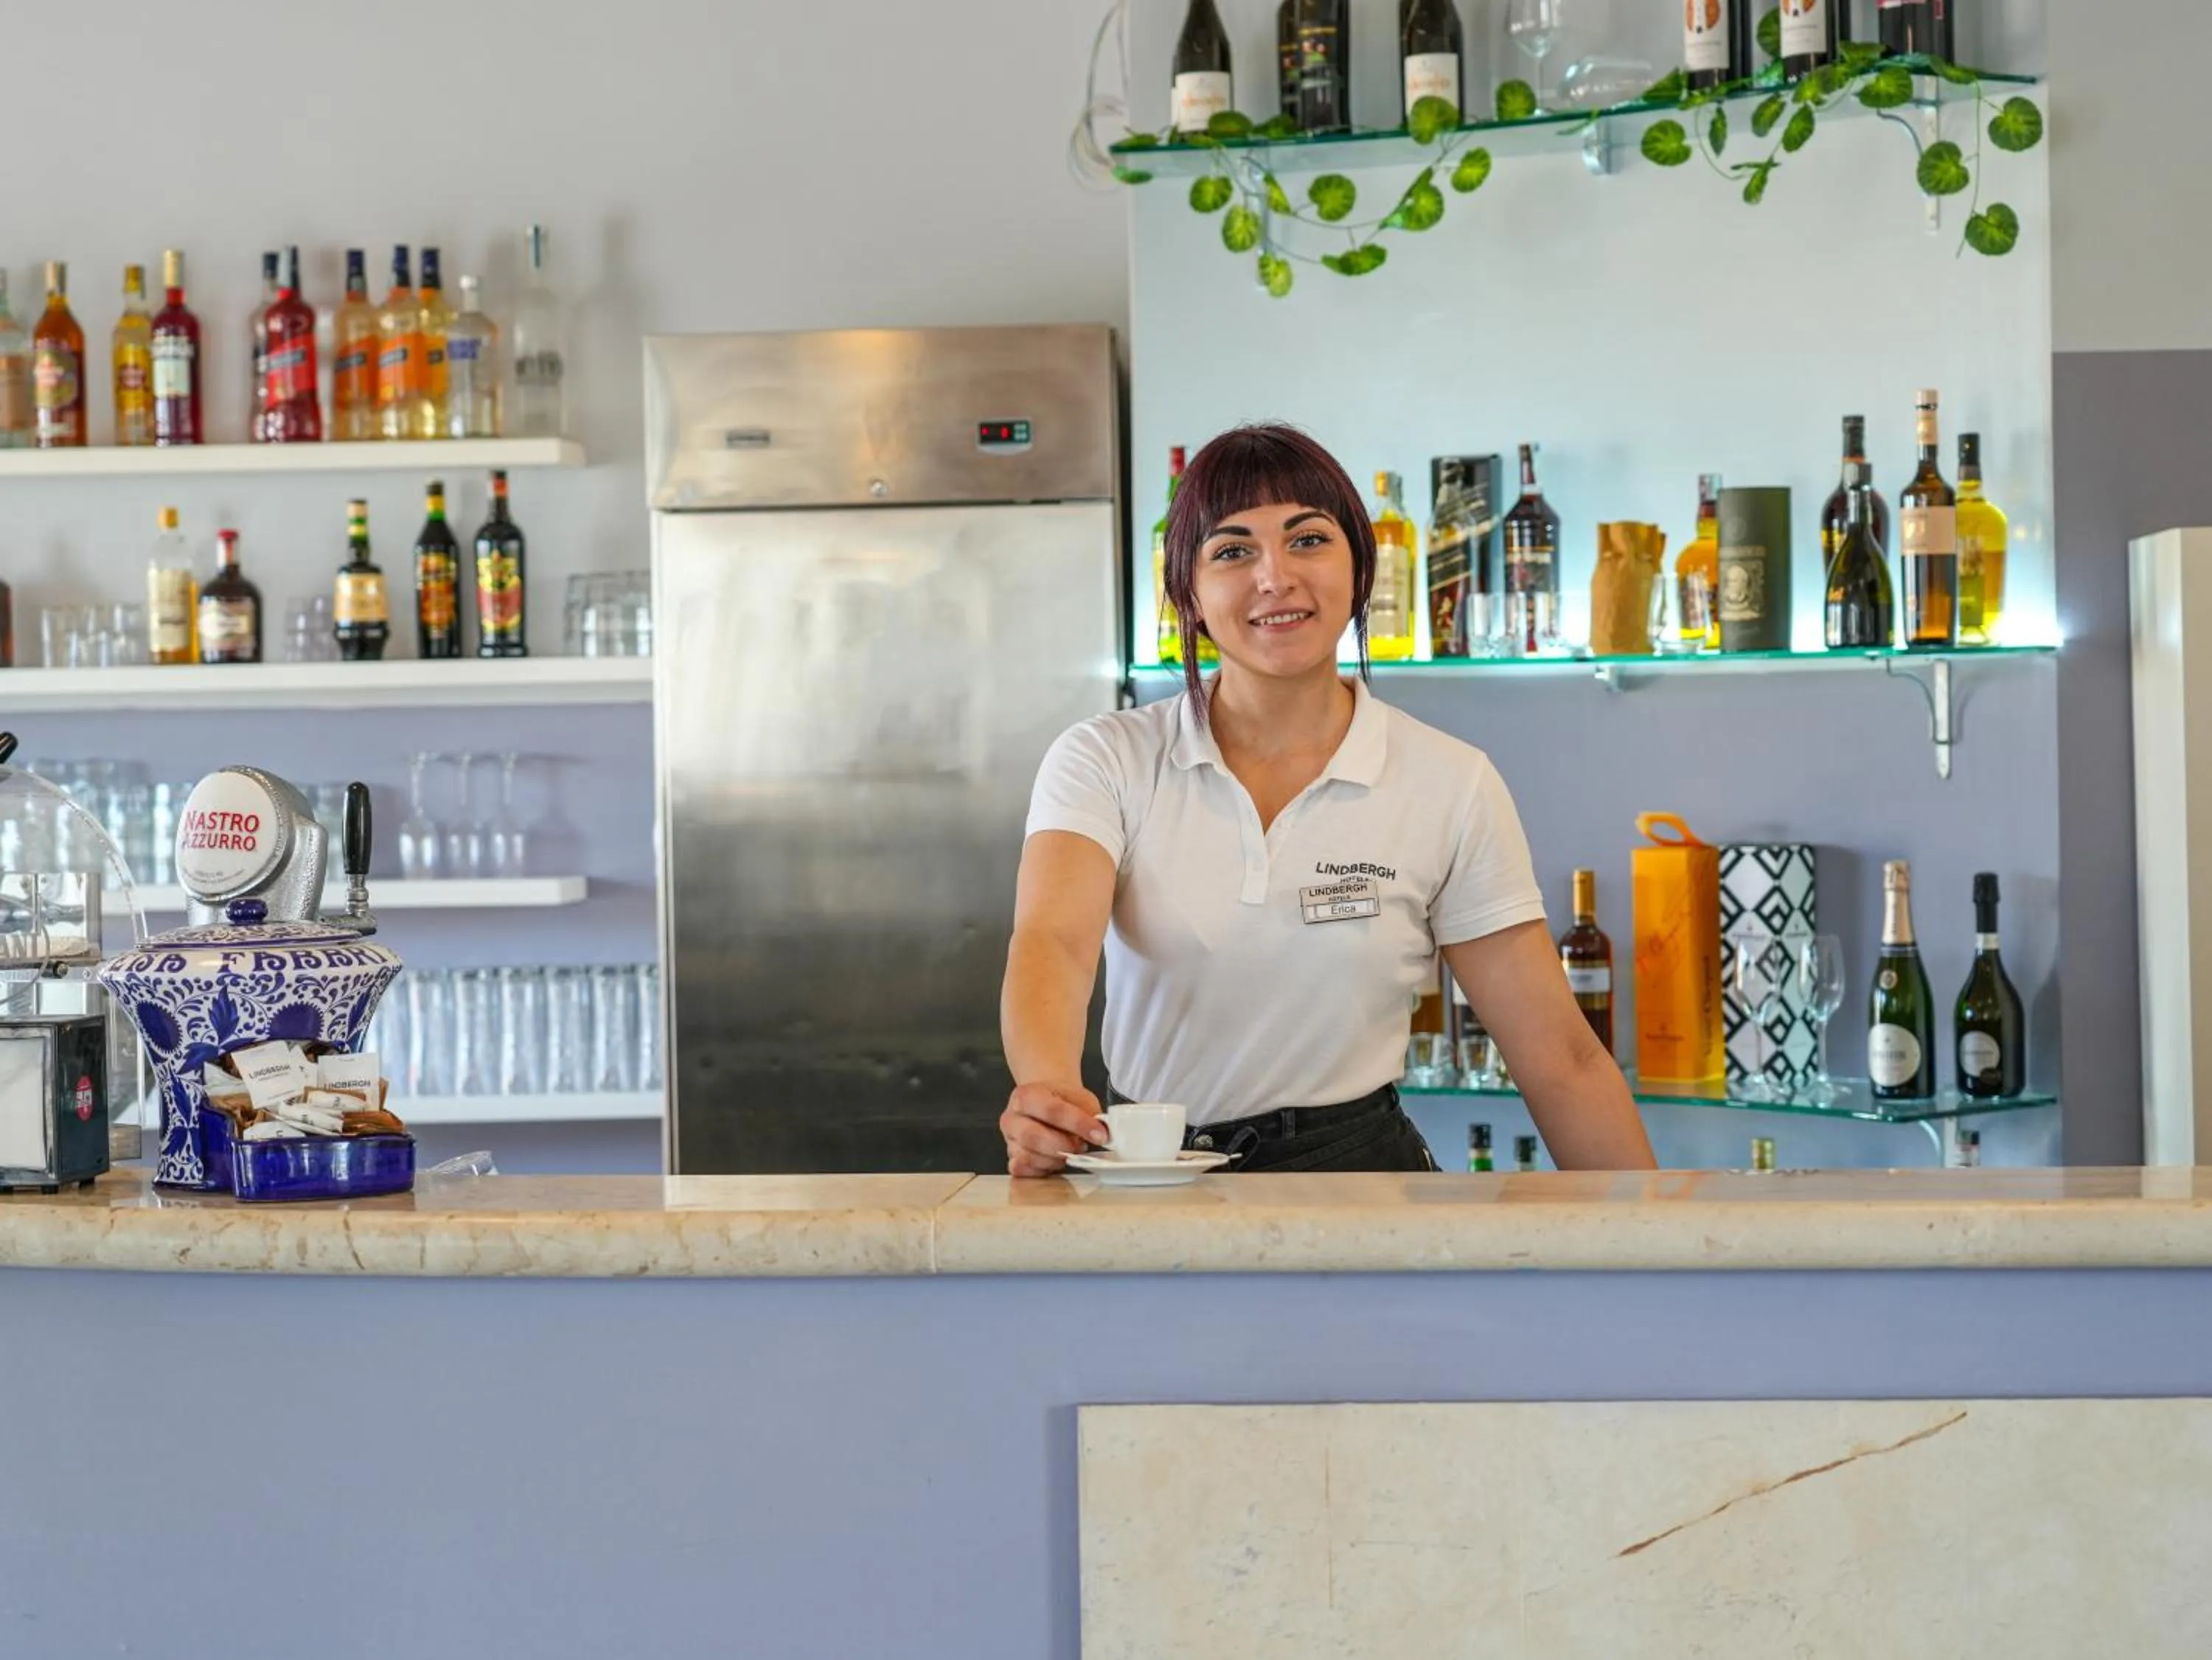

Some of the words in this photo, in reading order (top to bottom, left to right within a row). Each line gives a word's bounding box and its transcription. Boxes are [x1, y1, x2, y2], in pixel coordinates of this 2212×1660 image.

[184, 811, 260, 833] NASTRO
[181, 832, 257, 851] AZZURRO
[1315, 861, 1396, 880] LINDBERGH
[1308, 883, 1368, 897] LINDBERGH
[1331, 904, 1357, 915] Erica
